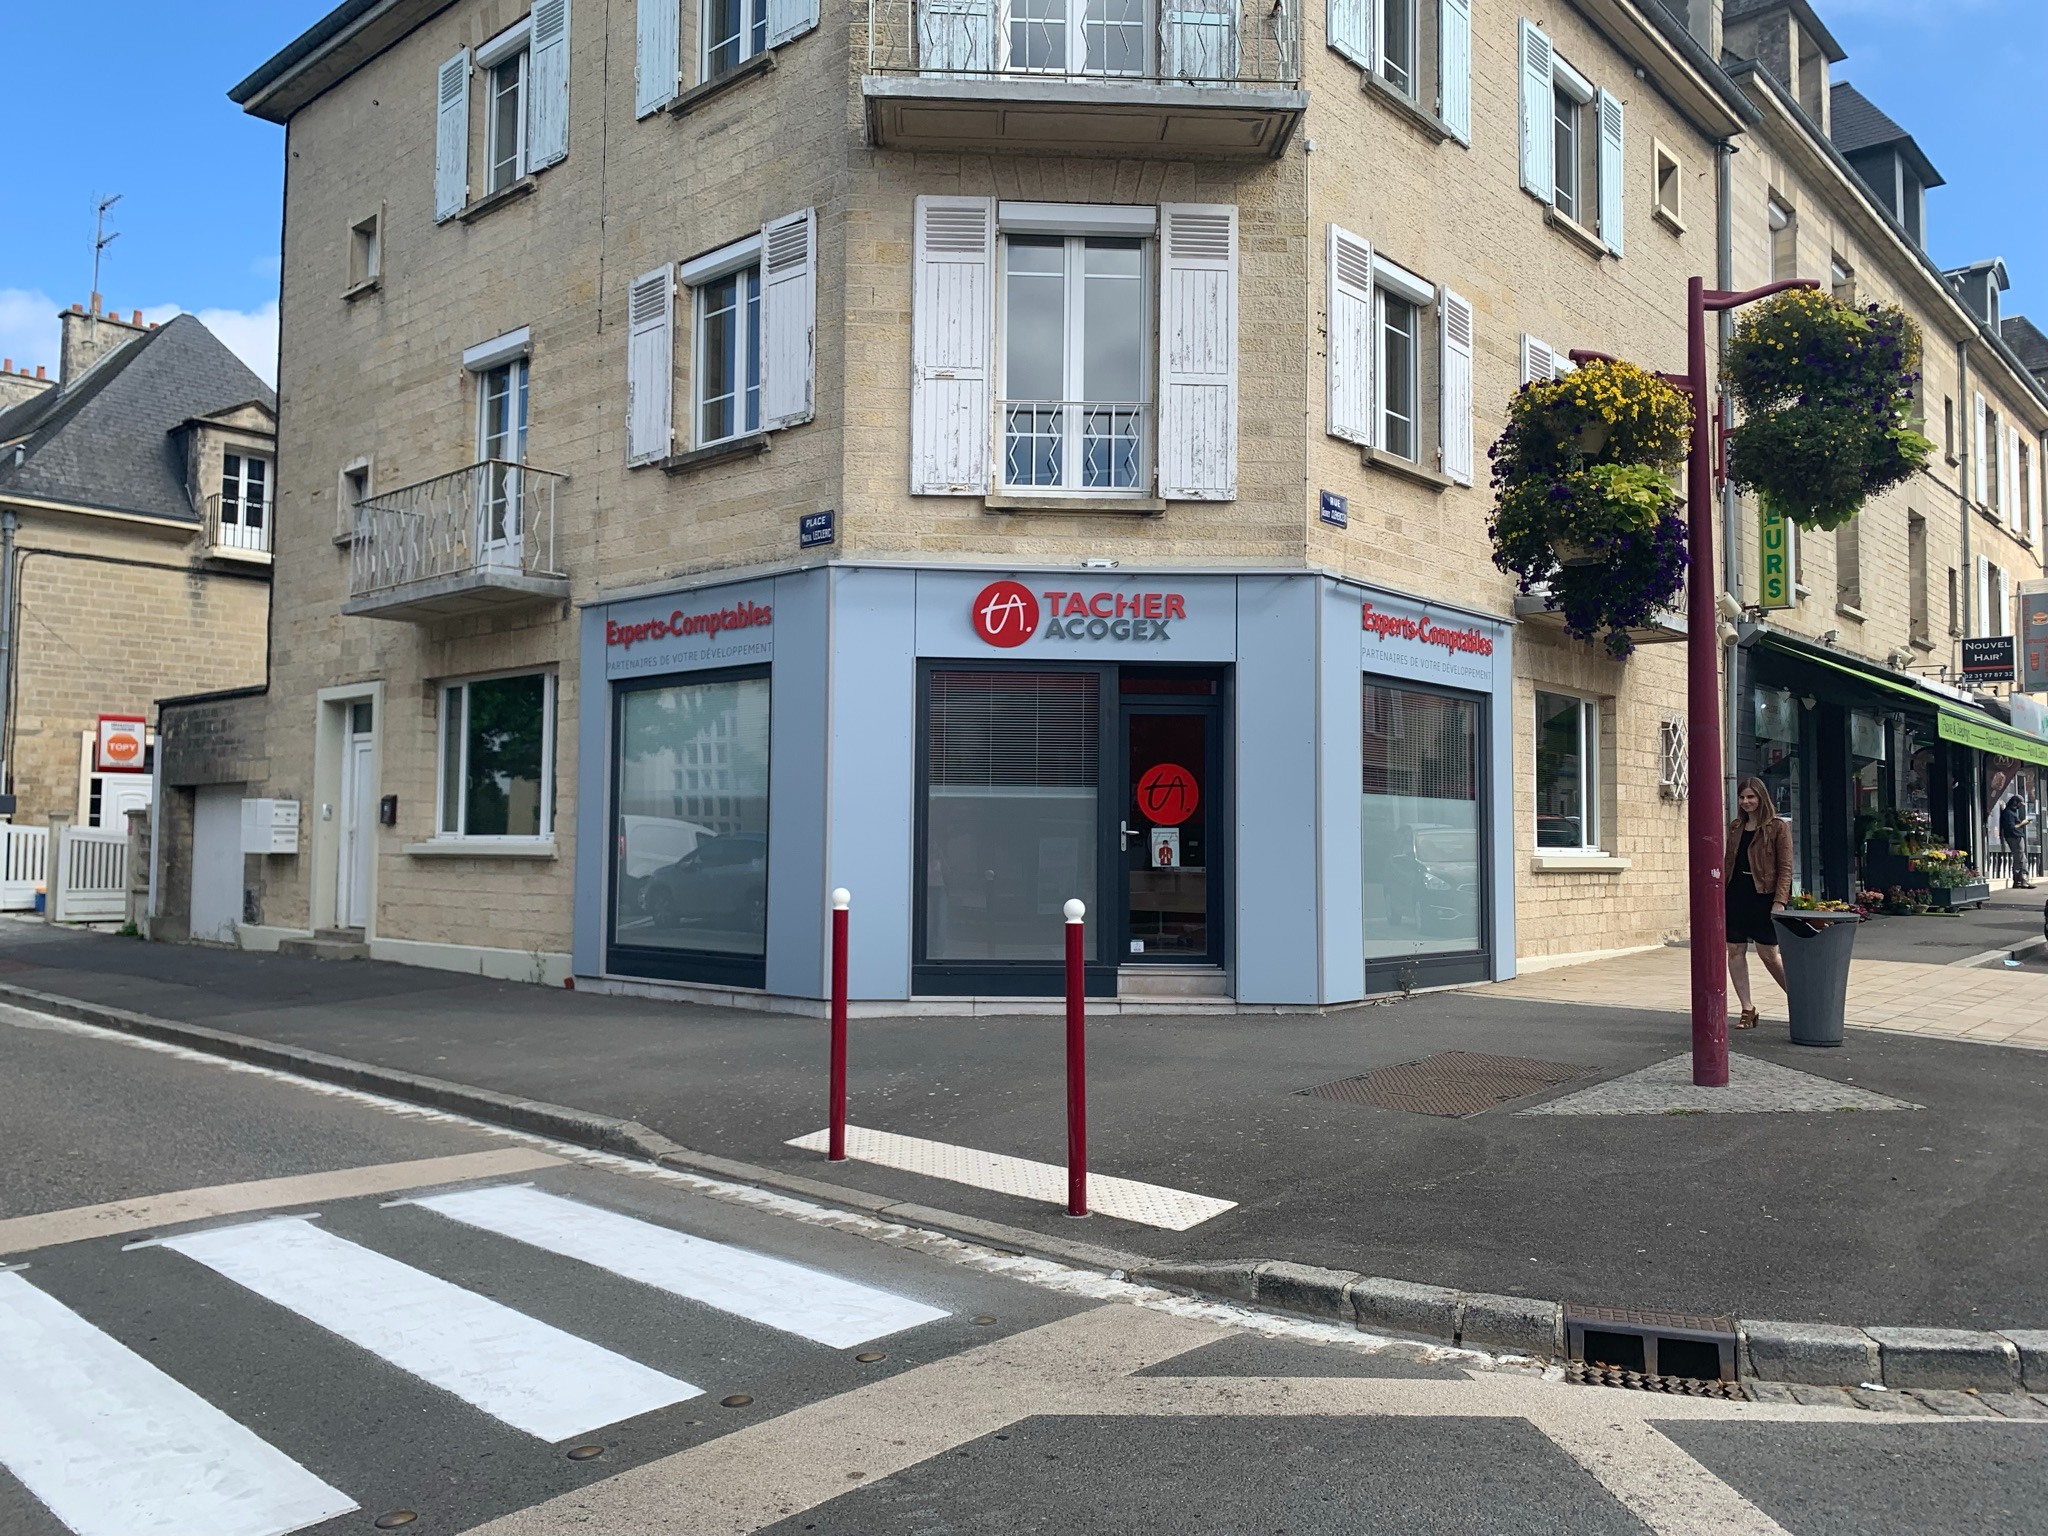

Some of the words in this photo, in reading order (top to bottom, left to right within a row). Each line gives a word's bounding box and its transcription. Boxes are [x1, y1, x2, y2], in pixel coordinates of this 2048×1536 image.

[1329, 496, 1341, 508] RUE
[805, 516, 826, 528] PLACE
[1043, 591, 1187, 619] TACHER
[606, 599, 773, 651] Experts-Comptables
[1044, 617, 1172, 641] ACOGEX
[1362, 602, 1493, 656] Experts-Comptables
[607, 655, 658, 672] PARTENAIRES
[660, 654, 670, 666] DE
[672, 650, 698, 664] VOTRE
[701, 641, 773, 661] DÉVELOPPEMENT
[1965, 641, 2012, 651] NOUVEL
[1361, 647, 1408, 666] PARTENAIRES
[1410, 656, 1419, 668] DE
[1420, 658, 1441, 672] VOTRE
[1441, 661, 1492, 681] DÉVELOPPEMENT
[108, 742, 137, 752] TOPY
